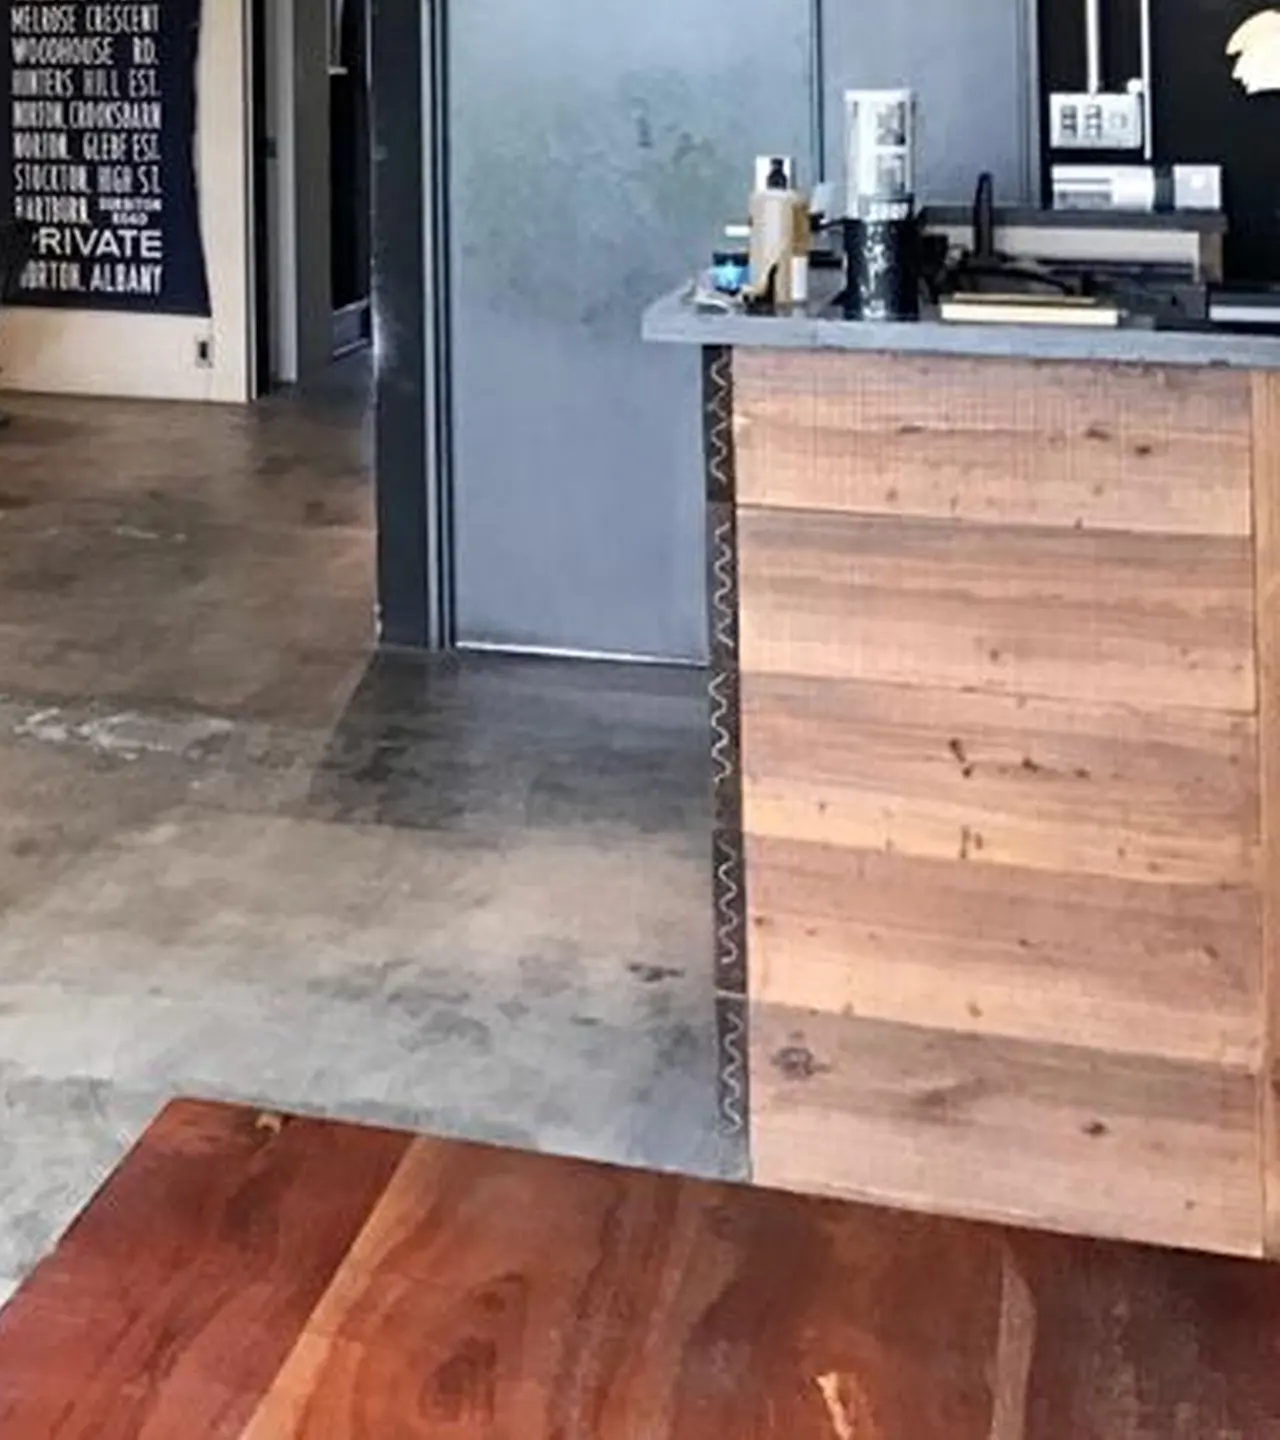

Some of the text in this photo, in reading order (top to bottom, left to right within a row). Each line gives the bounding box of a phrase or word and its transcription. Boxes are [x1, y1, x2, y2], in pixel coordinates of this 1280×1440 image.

[11, 4, 159, 34] MELROSE CRESCENT
[11, 36, 114, 65] WOODHOUSE
[31, 227, 163, 258] RIVATE
[90, 262, 162, 296] ALBANY
